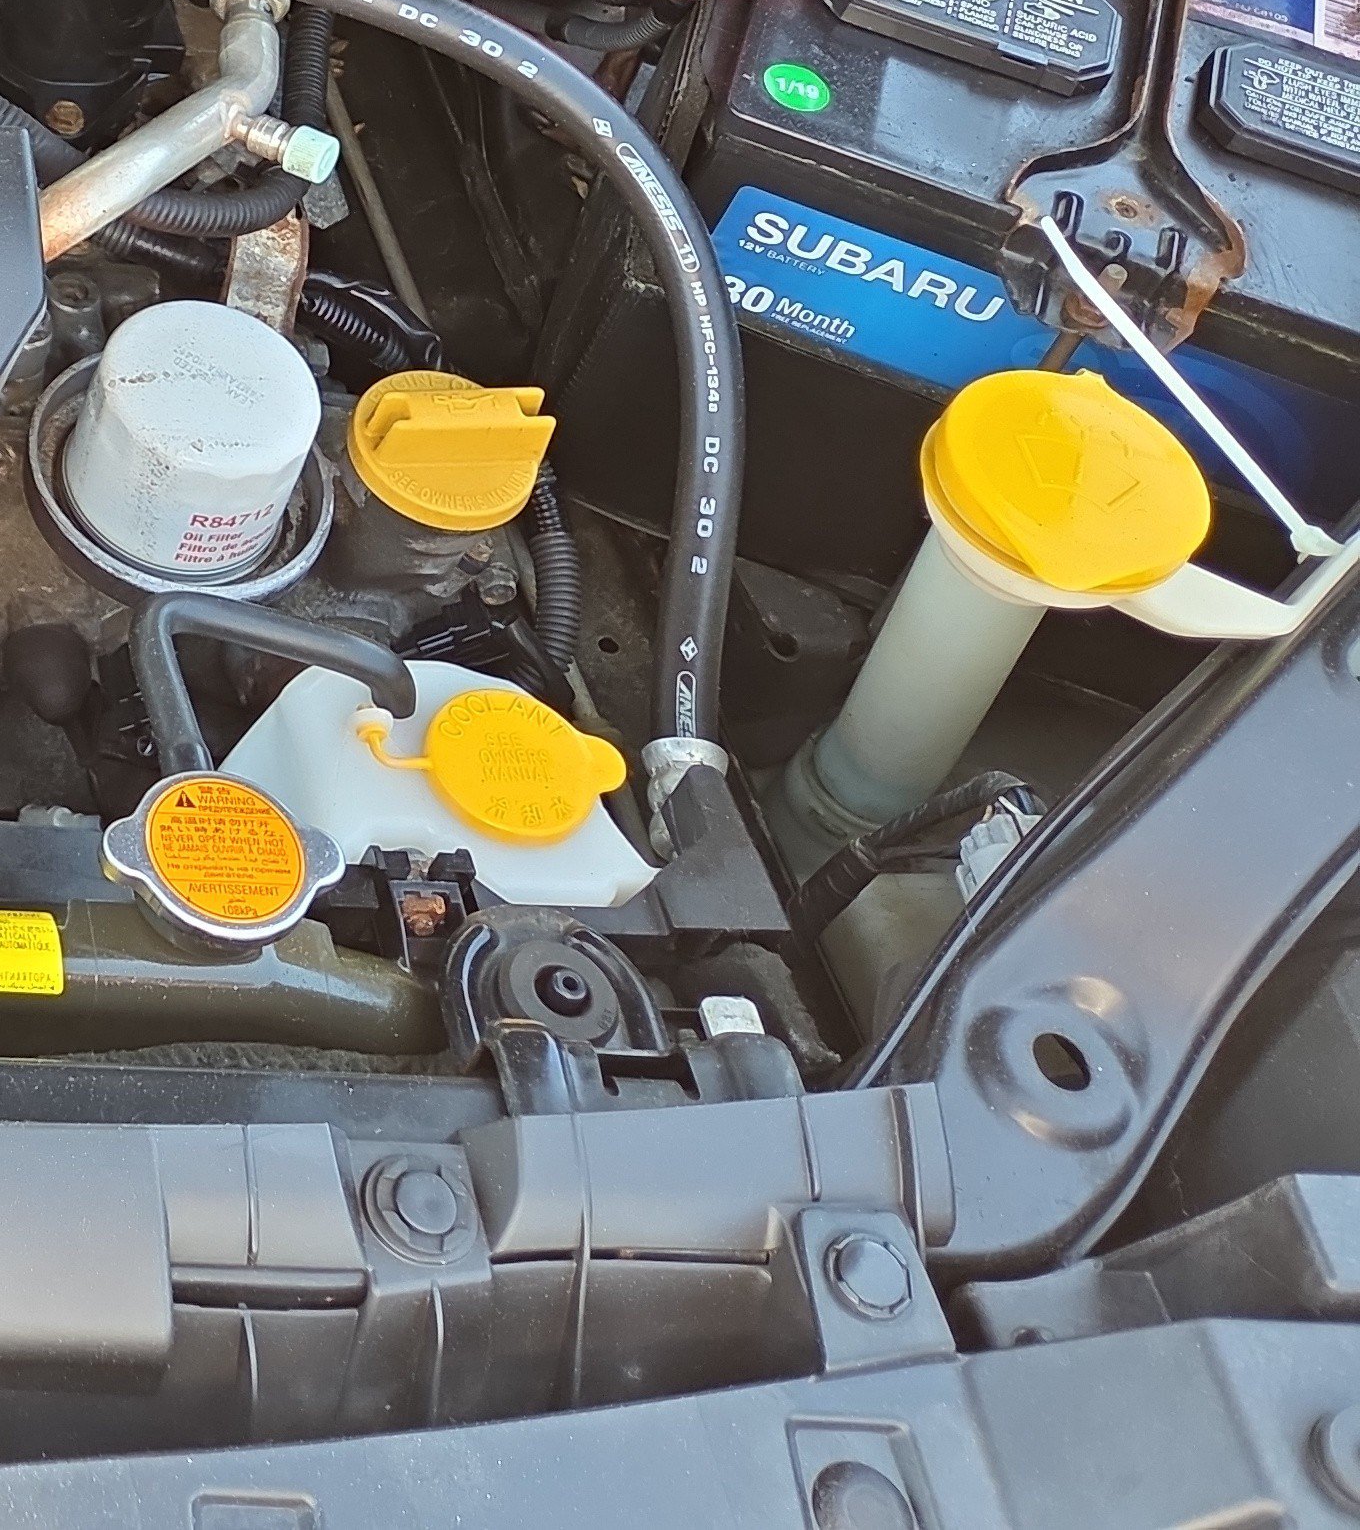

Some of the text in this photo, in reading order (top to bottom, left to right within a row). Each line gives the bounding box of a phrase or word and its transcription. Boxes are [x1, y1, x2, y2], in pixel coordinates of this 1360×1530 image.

[1015, 9, 1098, 44] SULFURIC ACID
[397, 3, 439, 28] DC
[458, 29, 505, 59] 30
[516, 60, 540, 80] 2
[774, 77, 820, 100] 1/19
[737, 238, 826, 277] 12V BATTERY
[745, 211, 1007, 322] SUBARU
[690, 281, 708, 308] HP
[723, 274, 857, 339] 30 Month
[702, 435, 722, 475] DC
[387, 468, 532, 511] SEE OWNER'S MANUAL
[189, 503, 275, 528] R84712
[695, 495, 717, 539] 30
[178, 542, 239, 554] Filtro de
[182, 531, 244, 543] Oil Filter
[174, 553, 213, 563] Filtre
[689, 554, 709, 576] 2
[438, 693, 569, 740] COOLANT
[484, 731, 522, 748] SEE
[480, 748, 550, 766] OWNERS
[483, 766, 555, 782] MANUAL
[196, 795, 256, 807] WARNING
[161, 834, 194, 843] NEVER
[198, 834, 226, 845] OPEN
[229, 836, 261, 846] WHEN
[162, 843, 175, 852] NE
[178, 844, 209, 854] JAMAIS
[188, 883, 280, 896] AVERTISSEMENT
[221, 904, 259, 917] 108kPa
